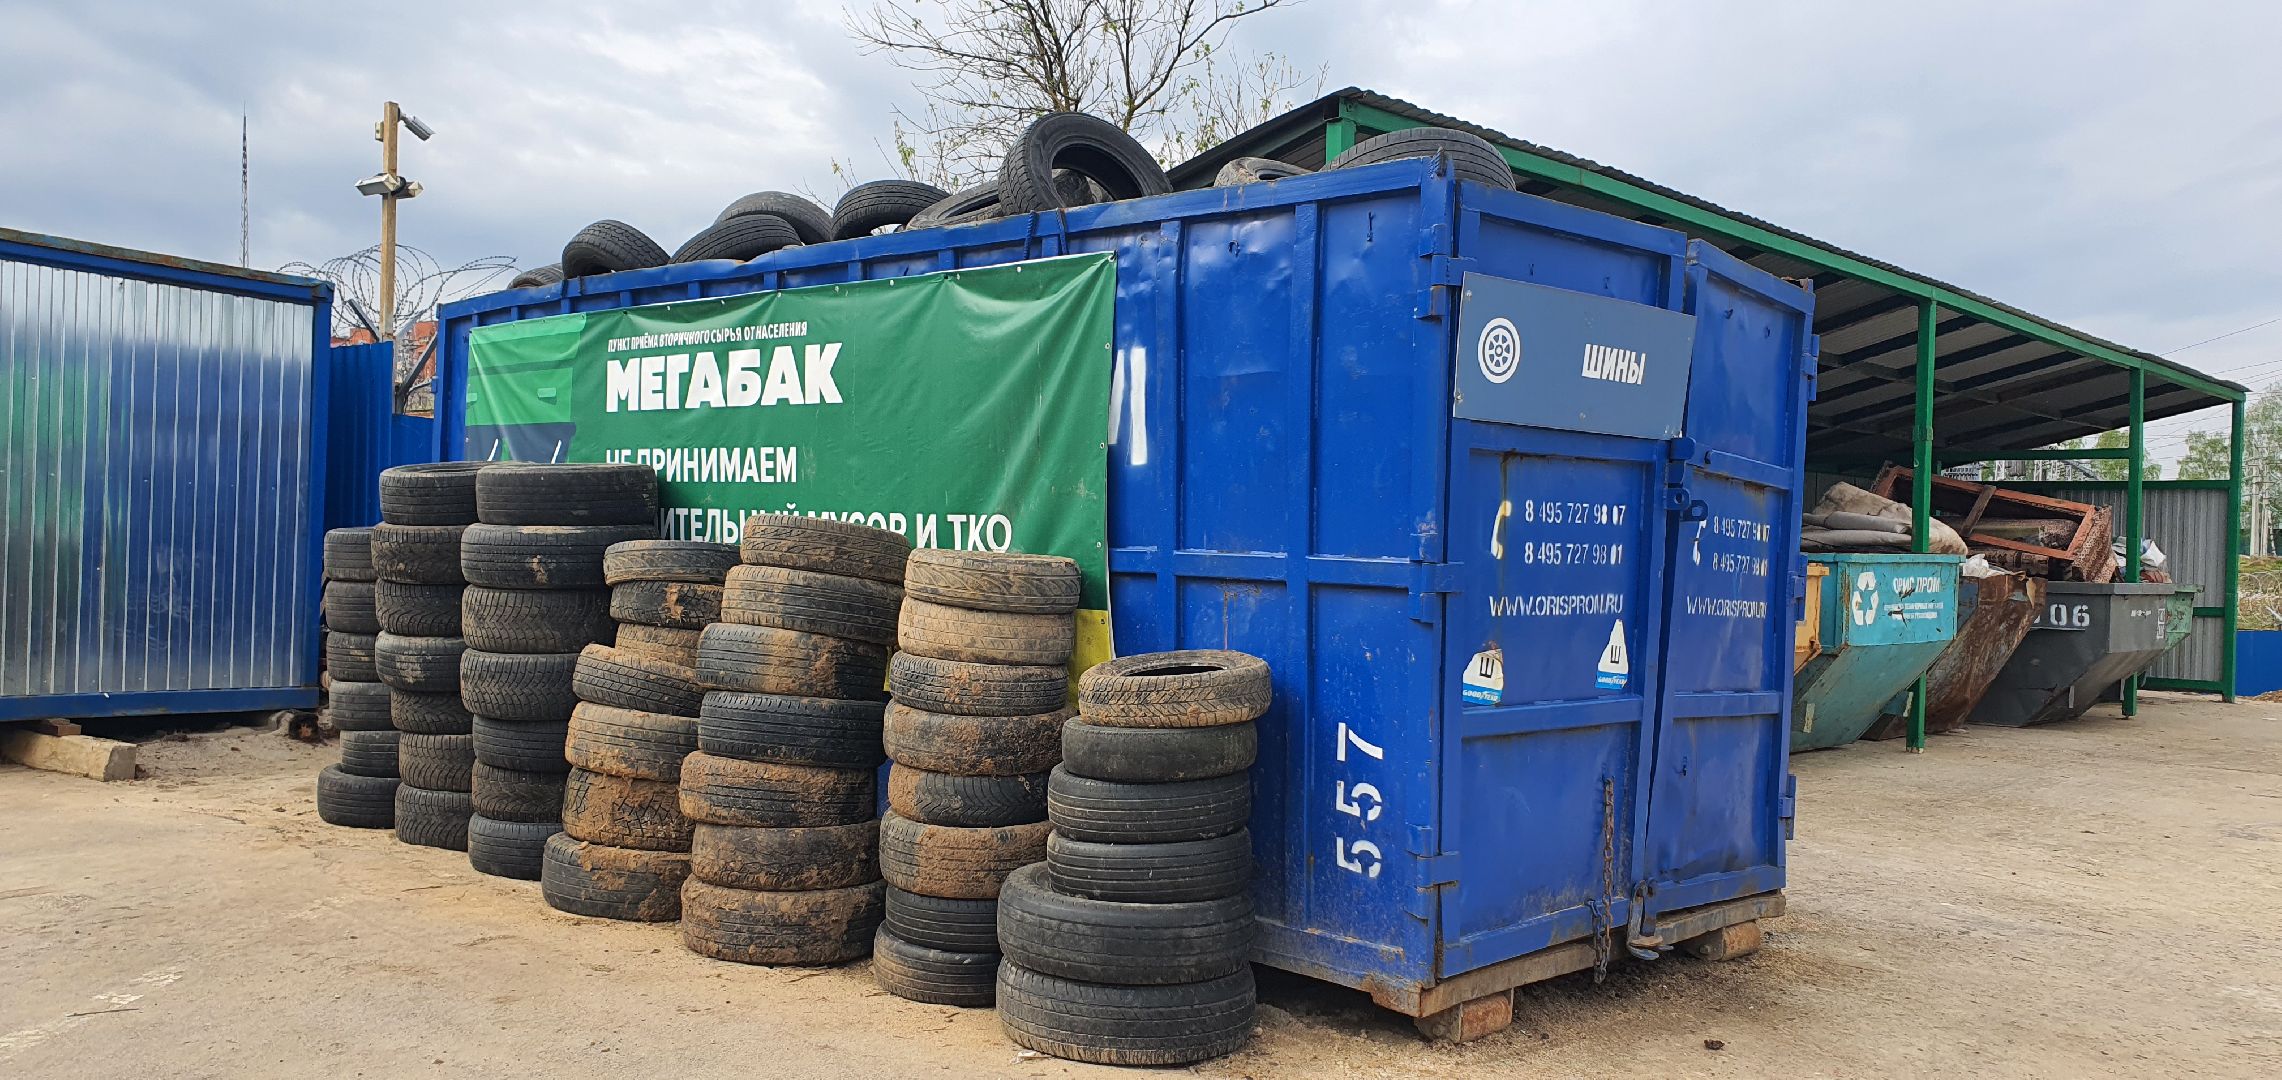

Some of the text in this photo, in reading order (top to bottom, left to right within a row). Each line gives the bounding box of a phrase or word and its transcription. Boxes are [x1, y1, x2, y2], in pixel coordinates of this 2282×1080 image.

[608, 321, 807, 352] ПУНКТ ПРИЁМА ВТОРИЧНОГО СЫРЬЯ ОТ НАСЕЛЕНИЯ
[1582, 344, 1646, 385] ШИНЫ
[606, 343, 843, 412] МЕГАБАК
[1526, 500, 1626, 526] 8 495 727 98 07
[916, 513, 938, 549] И
[947, 514, 1012, 553] ТКО
[1714, 516, 1719, 534] 8
[1722, 517, 1735, 537] 495
[1738, 519, 1751, 539] 727
[1525, 541, 1623, 565] 8 495 727 98 01
[1712, 552, 1718, 570] 8
[1489, 593, 1624, 617] WWW.ORISPROM.RU
[1610, 645, 1621, 664] Ш
[1479, 656, 1495, 679] Ш
[1336, 722, 1383, 878] 557
